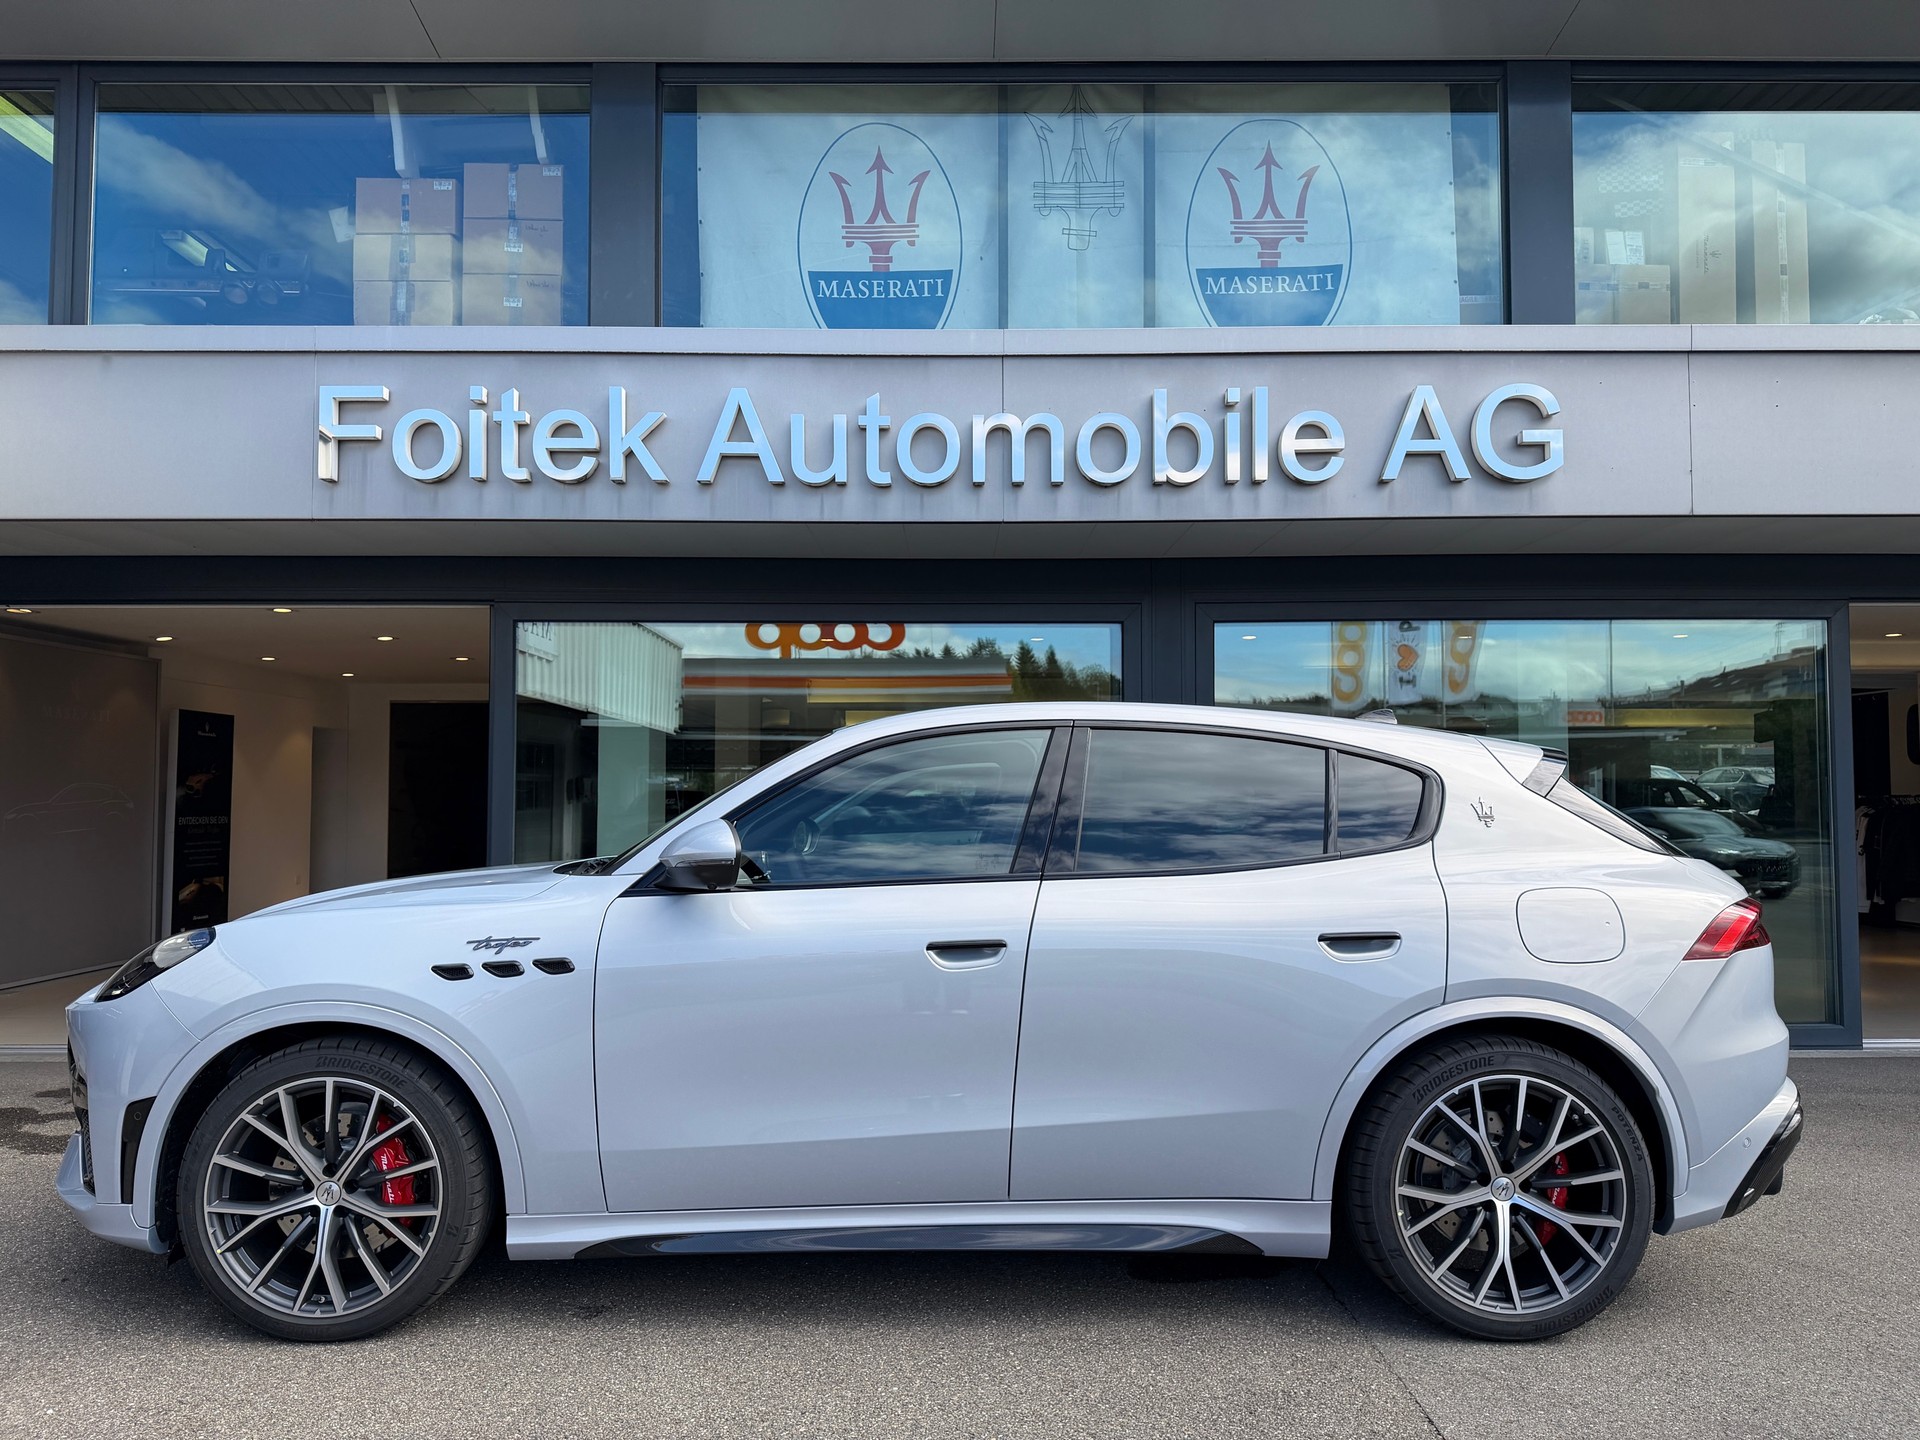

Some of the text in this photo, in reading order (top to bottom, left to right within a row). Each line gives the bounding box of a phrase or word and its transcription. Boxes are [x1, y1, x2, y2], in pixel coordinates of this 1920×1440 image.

[816, 277, 946, 300] MASERATI
[1204, 271, 1336, 296] MASERATI
[318, 383, 1565, 488] Foitek Automobile AG
[178, 816, 209, 825] ENTDECKEN
[218, 816, 228, 824] DEN
[466, 936, 541, 955] trofeo
[315, 1055, 408, 1089] BRIDGESTONE
[1413, 1054, 1495, 1105] BRIDGESTONE
[1611, 1106, 1643, 1162] POTENZA
[1531, 1286, 1614, 1334] BRIDGESTONE
